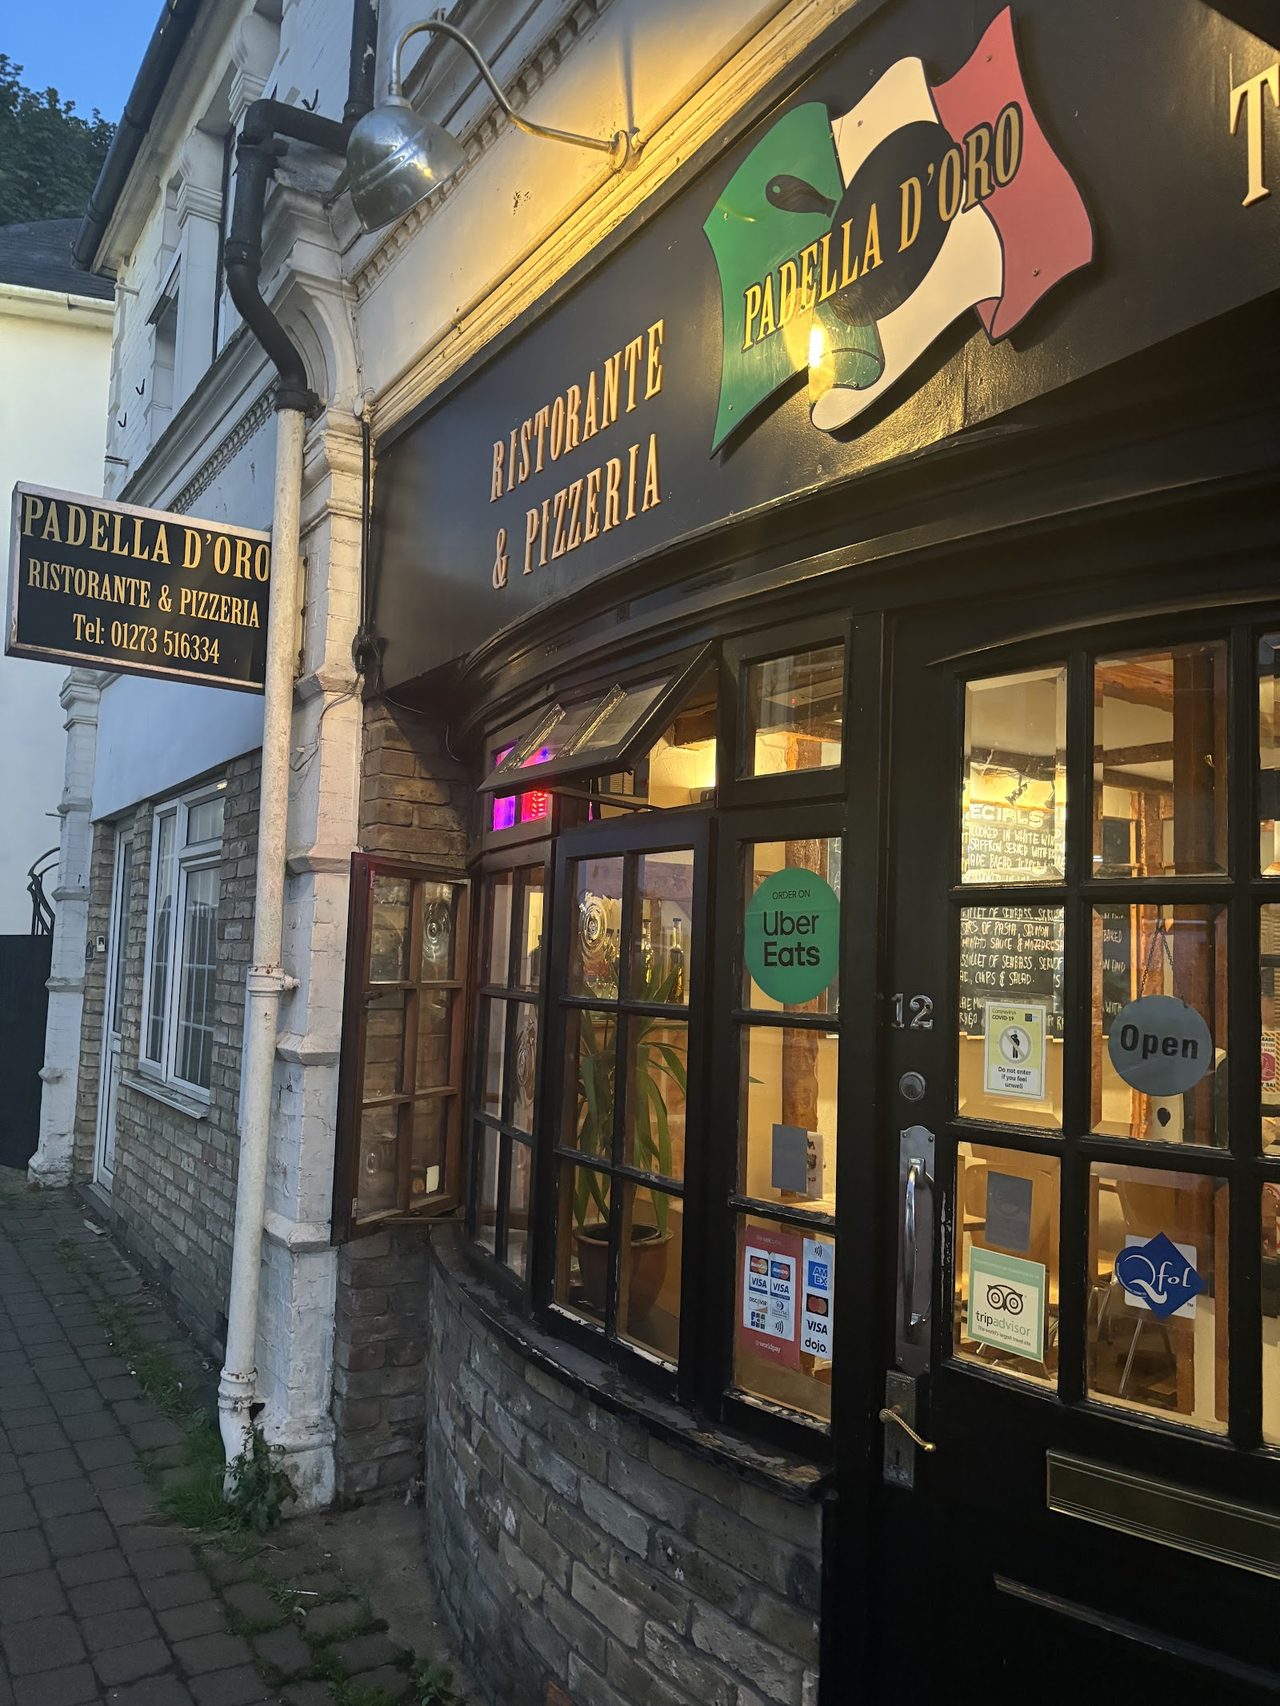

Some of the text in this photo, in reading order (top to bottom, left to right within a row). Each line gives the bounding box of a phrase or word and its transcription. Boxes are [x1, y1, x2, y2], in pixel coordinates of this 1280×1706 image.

[742, 106, 1020, 352] PADELLA D'ORO
[490, 319, 664, 502] RISTORANTE
[492, 433, 661, 590] & PIZZERIA
[22, 495, 271, 583] PADELLA D'ORO
[27, 558, 261, 629] RISTORANTE & PIZZERIA
[72, 612, 220, 665] Tel: 01273 516334
[1003, 829, 1011, 842] IN
[1014, 829, 1040, 845] WHITE
[772, 889, 811, 900] ORDER ON
[763, 911, 820, 936] Uber
[763, 941, 821, 967] Eats
[990, 937, 1013, 950] SAUCE
[890, 992, 935, 1030] 12
[1119, 1023, 1199, 1061] Open
[813, 1266, 828, 1278] AM
[815, 1276, 828, 1286] EX
[752, 1277, 790, 1294] VISA VISA
[806, 1319, 828, 1335] VISA
[976, 1311, 1031, 1336] tripadvisor
